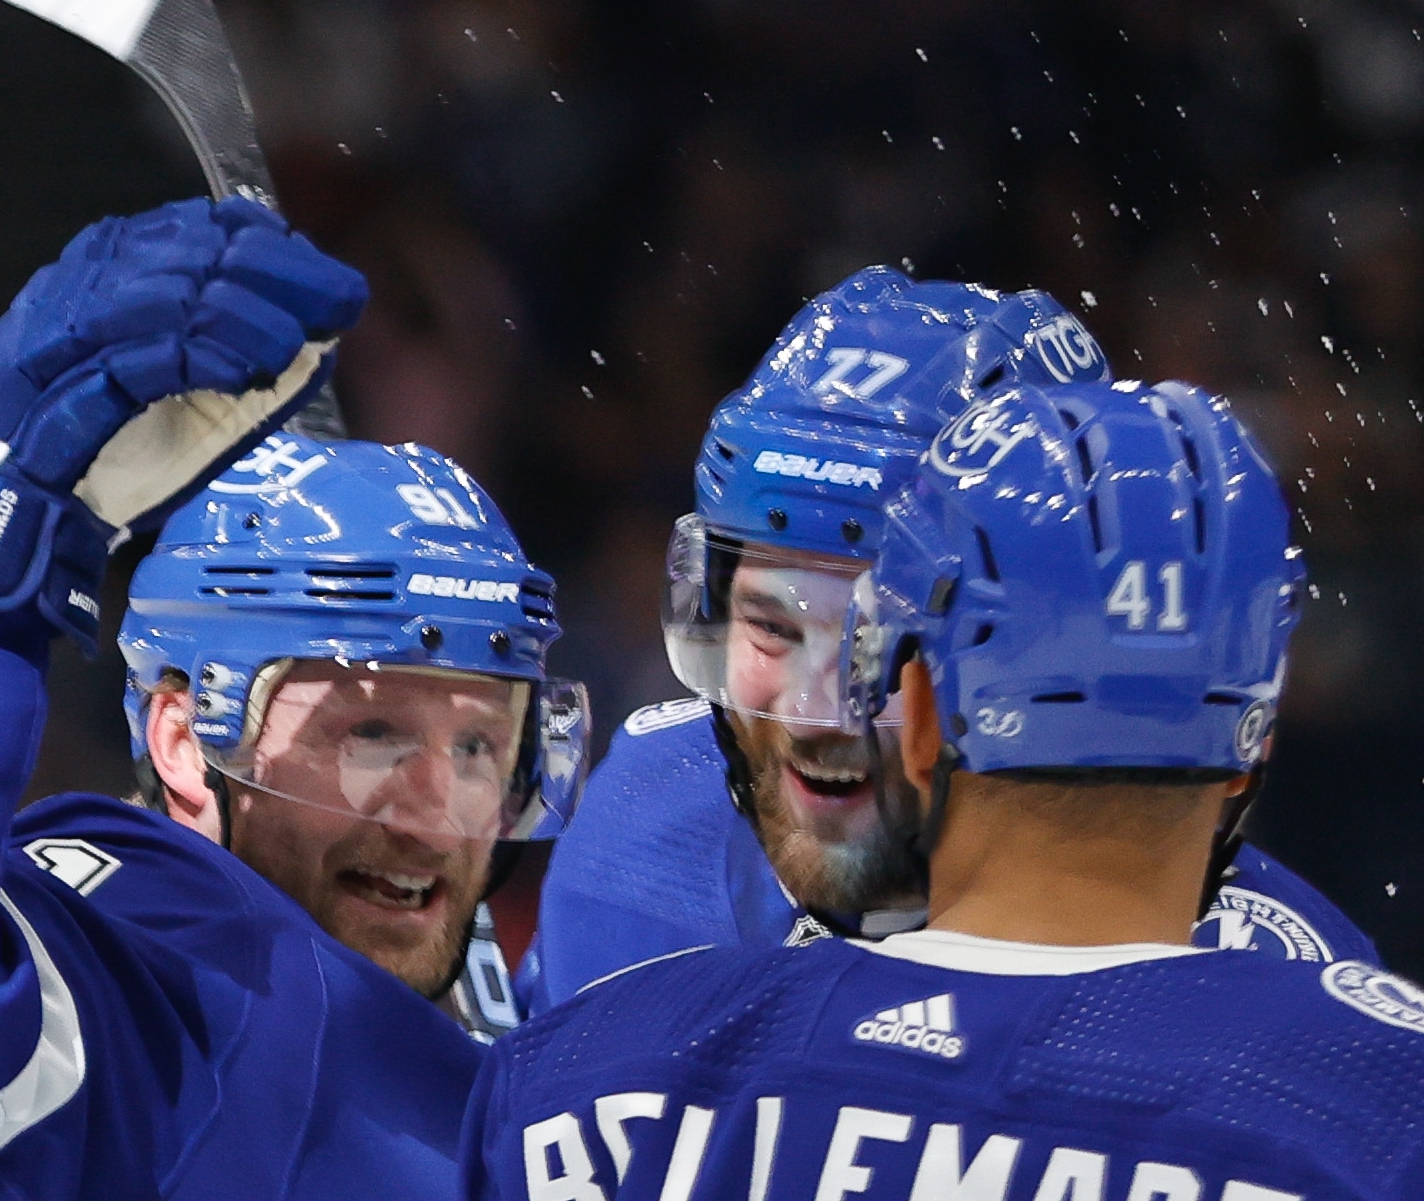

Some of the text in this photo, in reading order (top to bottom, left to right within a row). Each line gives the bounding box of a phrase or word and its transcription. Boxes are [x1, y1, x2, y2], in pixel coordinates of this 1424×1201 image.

[810, 347, 910, 400] 77
[396, 483, 479, 530] 91
[1106, 561, 1186, 631] 41
[854, 1020, 963, 1059] adidas
